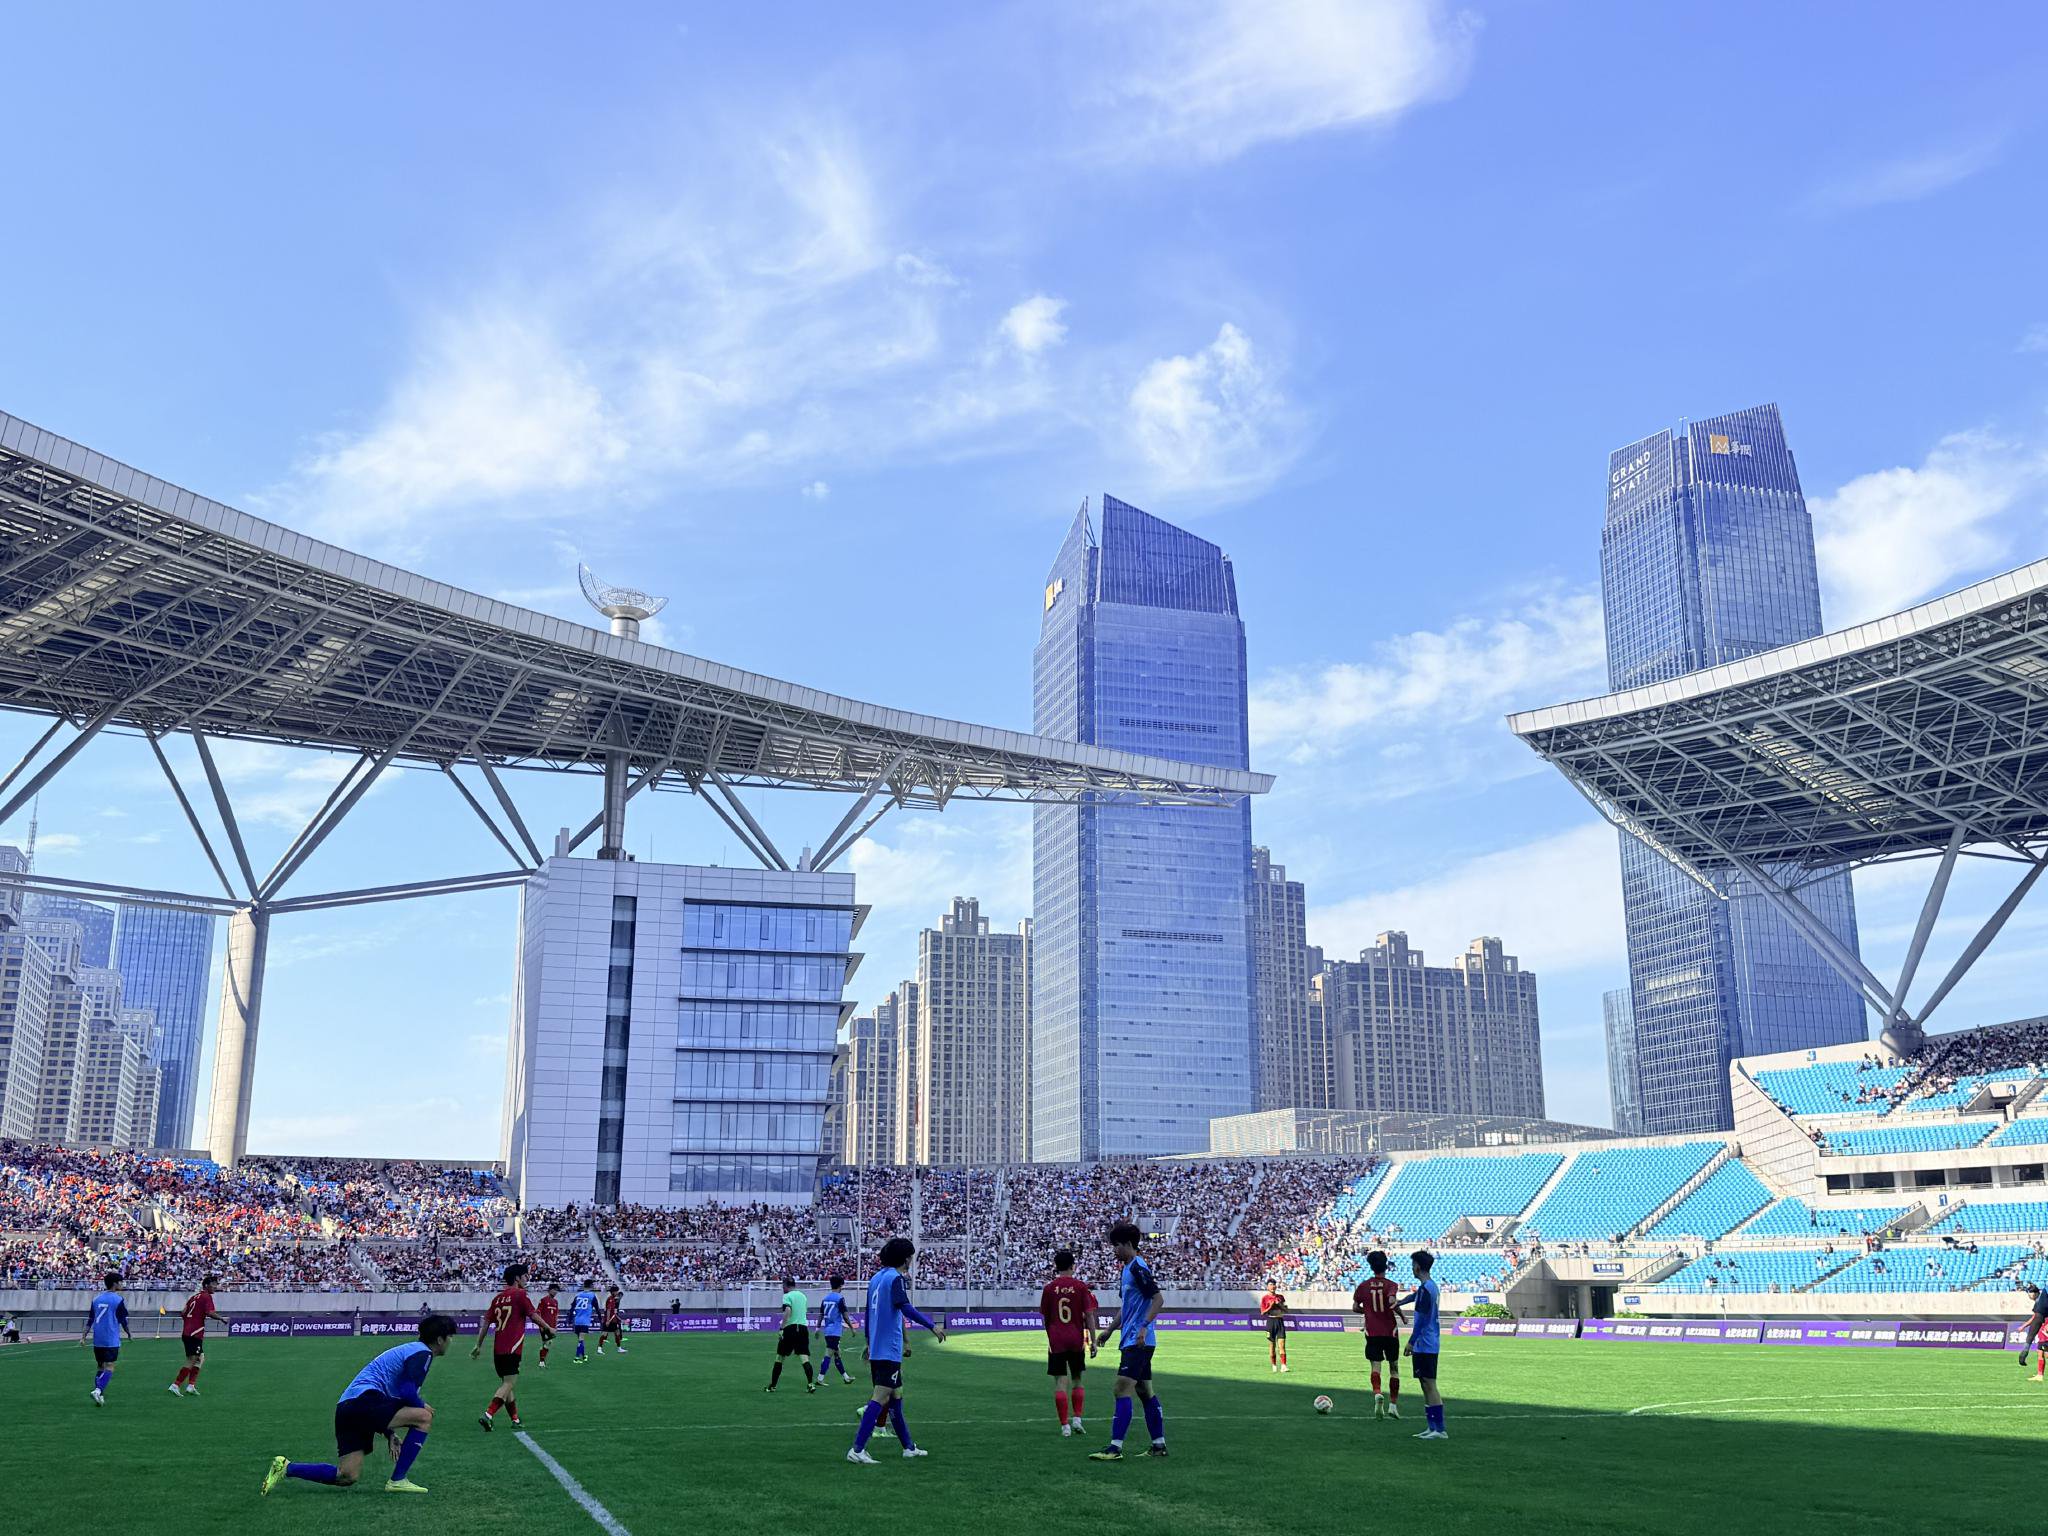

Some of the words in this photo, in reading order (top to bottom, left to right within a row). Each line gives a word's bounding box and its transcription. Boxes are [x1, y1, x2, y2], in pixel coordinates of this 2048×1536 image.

[1612, 451, 1651, 483] GRAND
[1613, 469, 1649, 501] HYATT
[186, 1300, 196, 1318] 2
[575, 1297, 589, 1310] 28
[823, 1301, 836, 1318] 77
[1370, 1289, 1384, 1312] 11
[96, 1303, 108, 1324] 7
[494, 1305, 513, 1331] 37
[1058, 1297, 1072, 1324] 6
[231, 1322, 290, 1333] 合肥体育中心
[951, 1317, 993, 1326] 合肥市体育局
[891, 1369, 899, 1384] 4
